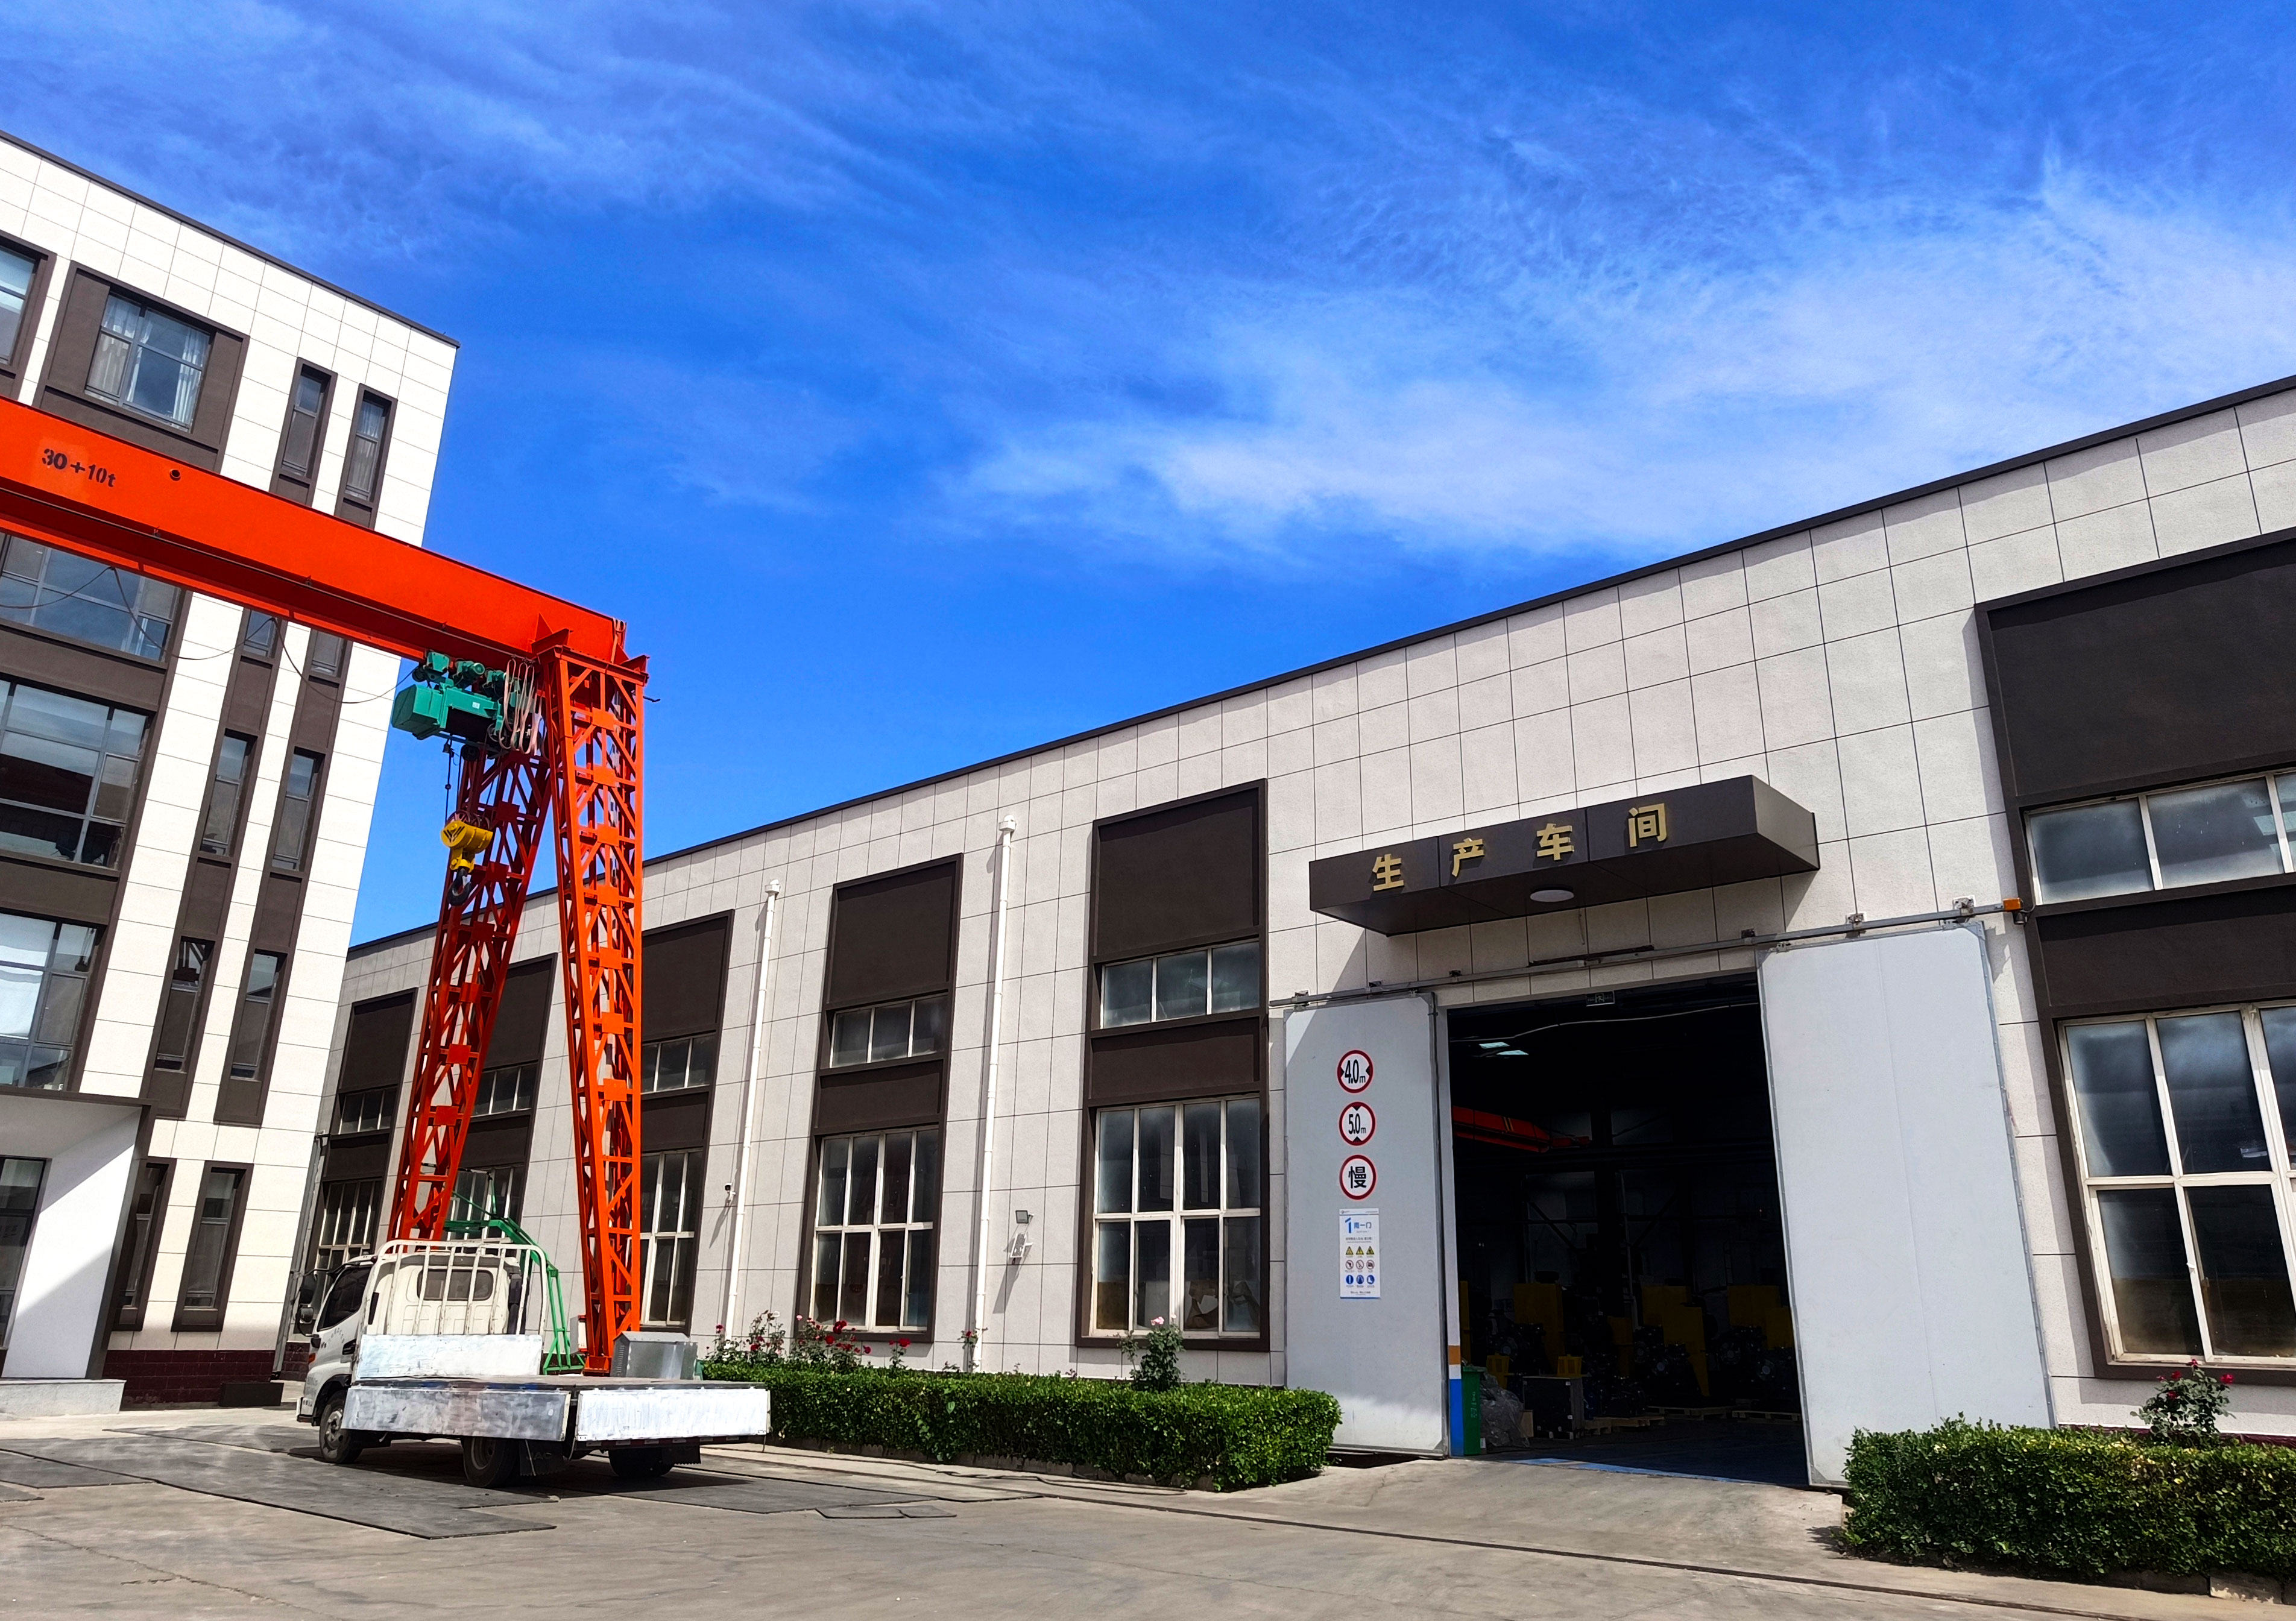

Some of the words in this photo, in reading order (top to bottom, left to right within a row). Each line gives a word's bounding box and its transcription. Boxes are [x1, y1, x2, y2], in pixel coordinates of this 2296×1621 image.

[42, 449, 116, 487] 30+10t
[1372, 803, 1668, 891] 生产车间
[1345, 1059, 1366, 1084] 4.0m
[1348, 1113, 1366, 1134] 5.0m
[1348, 1166, 1367, 1189] 慢
